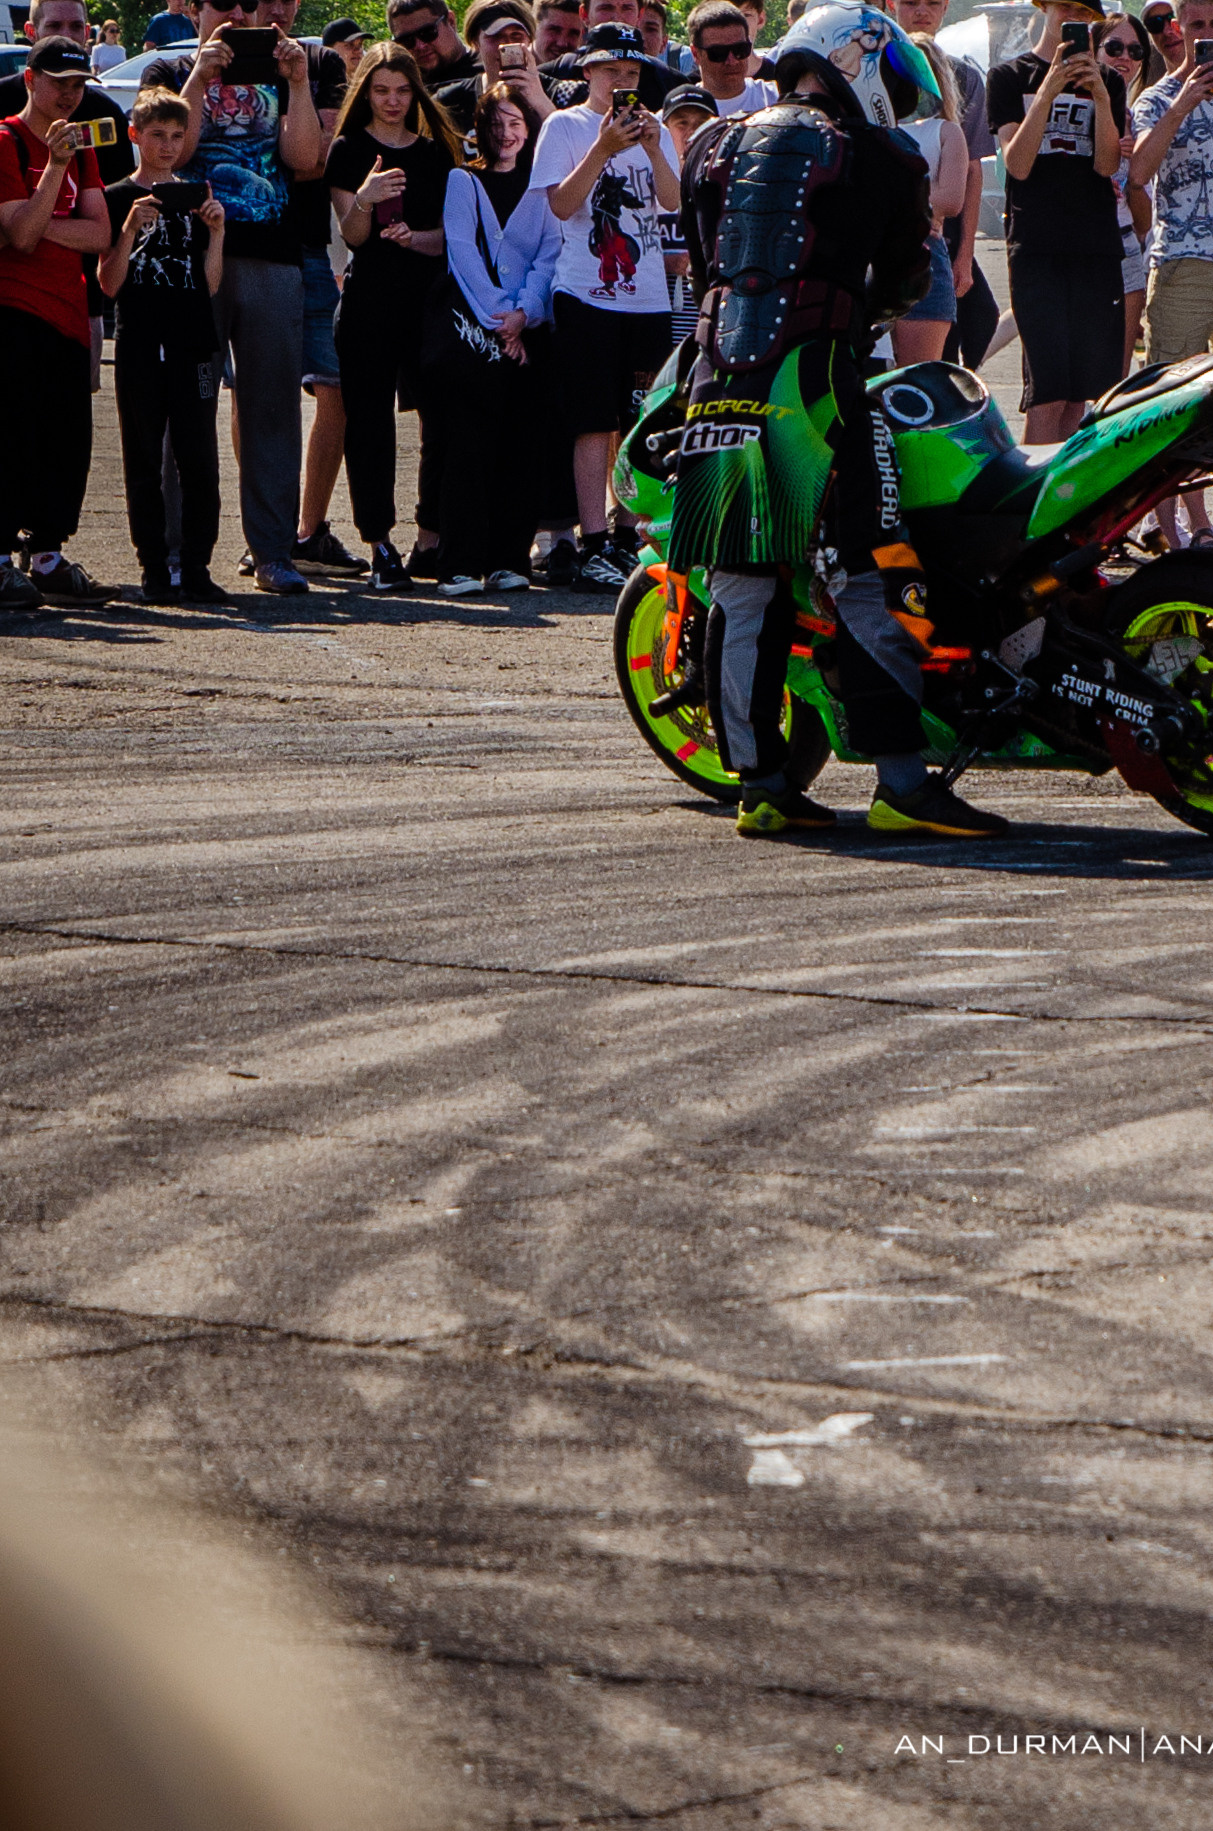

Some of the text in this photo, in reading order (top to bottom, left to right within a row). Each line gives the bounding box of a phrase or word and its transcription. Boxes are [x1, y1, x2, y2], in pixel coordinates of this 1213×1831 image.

[1047, 102, 1088, 125] FC
[703, 399, 794, 420] CIRCUIT
[682, 423, 760, 454] thor
[870, 409, 900, 529] MADHEAD
[1051, 683, 1065, 698] IS
[1068, 690, 1094, 708] NOT
[1061, 673, 1154, 718] STUNT RIDING
